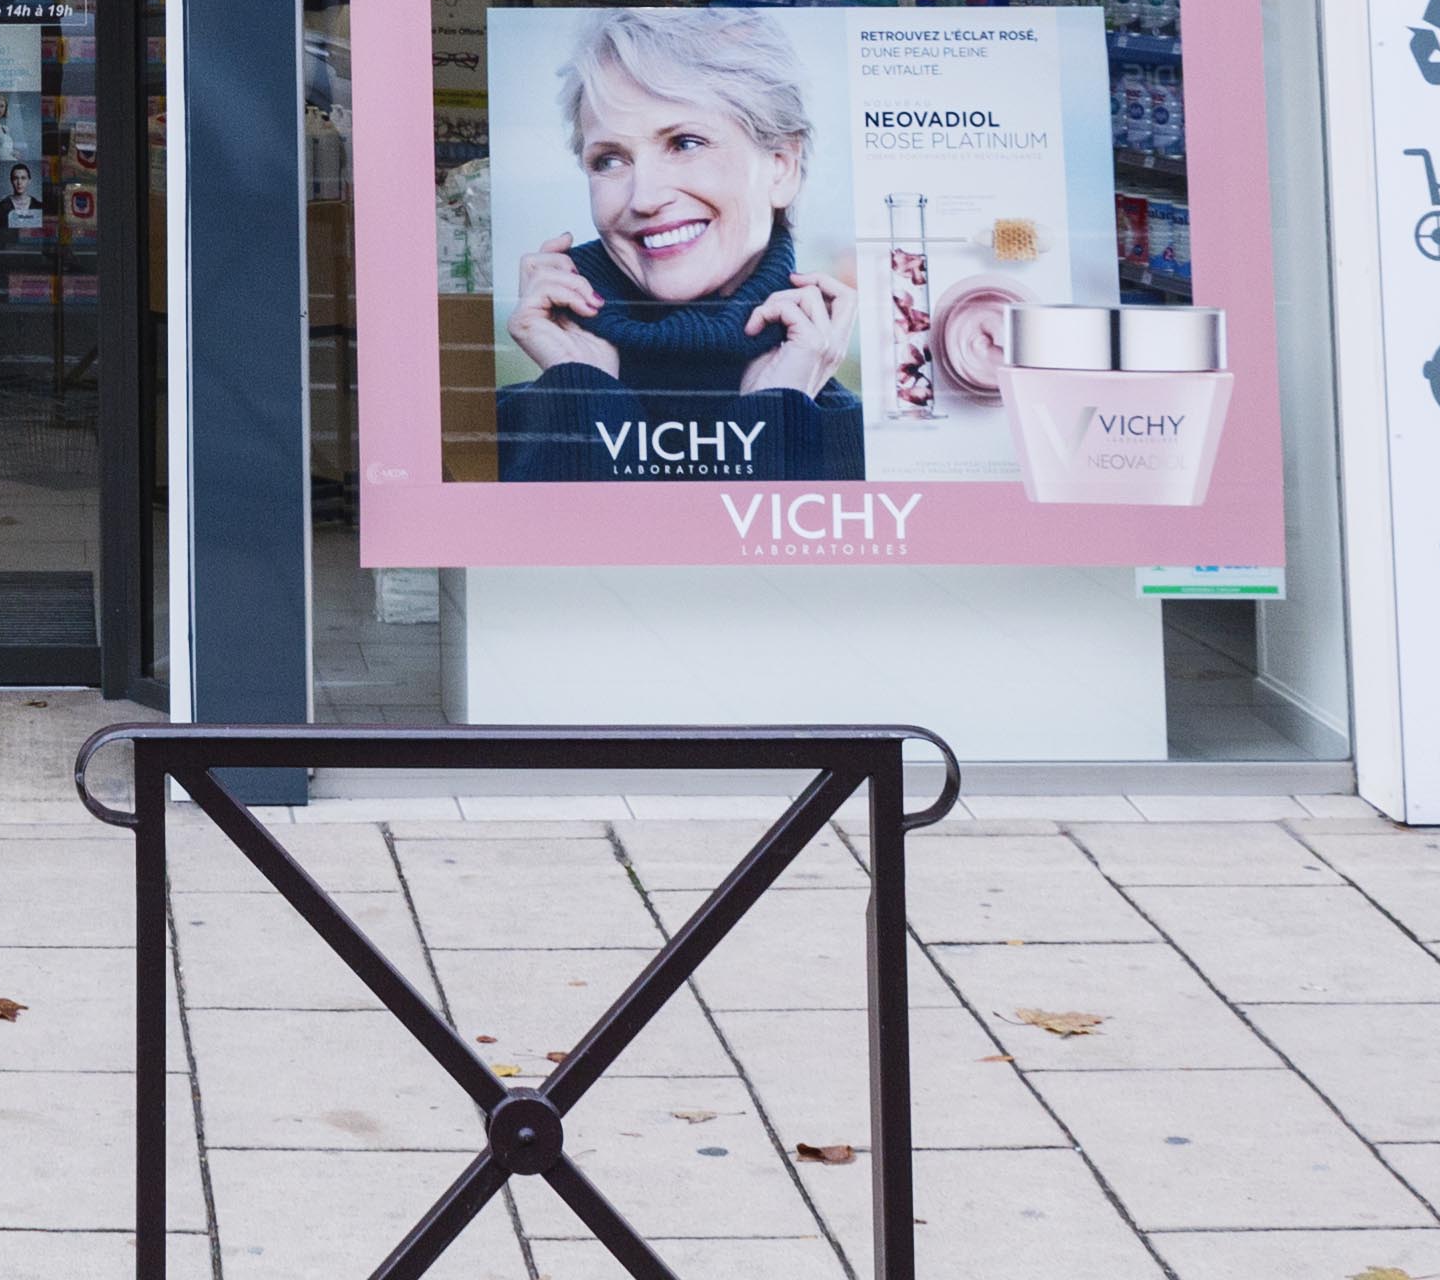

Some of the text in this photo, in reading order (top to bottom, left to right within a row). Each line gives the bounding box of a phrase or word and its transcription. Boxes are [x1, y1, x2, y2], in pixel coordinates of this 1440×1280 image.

[5, 4, 31, 19] 14h
[34, 4, 44, 19] à
[47, 4, 73, 19] 19h
[860, 29, 1038, 42] RETROUVEZ L'ÉCLAT ROSÉ,
[865, 111, 1001, 128] NEOVADIOL
[865, 132, 1049, 150] ROSE PLATINIUM
[1098, 414, 1185, 437] VICHY
[595, 421, 766, 461] VICHY
[613, 464, 754, 475] LABORATOIRES
[720, 493, 923, 540] VICHY
[741, 544, 908, 556] LABORATOIRES
